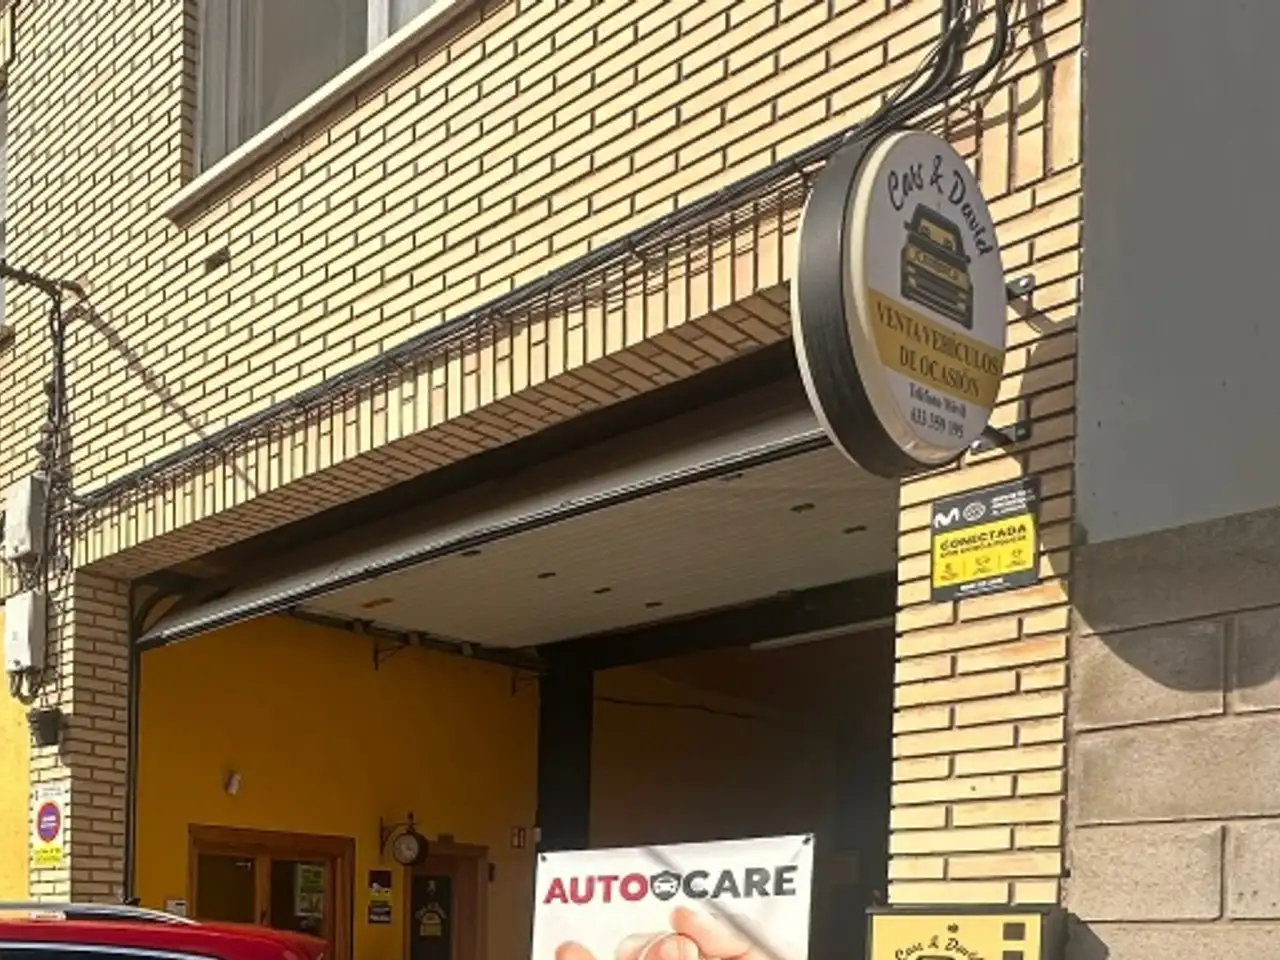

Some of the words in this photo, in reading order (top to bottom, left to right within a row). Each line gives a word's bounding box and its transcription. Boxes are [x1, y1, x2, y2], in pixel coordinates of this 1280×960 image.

[929, 154, 944, 195] &
[877, 300, 922, 345] VENTA
[899, 345, 917, 372] DE
[939, 523, 1027, 552] CONECTADA
[543, 873, 649, 905] AUTO
[682, 865, 799, 900] CARE
